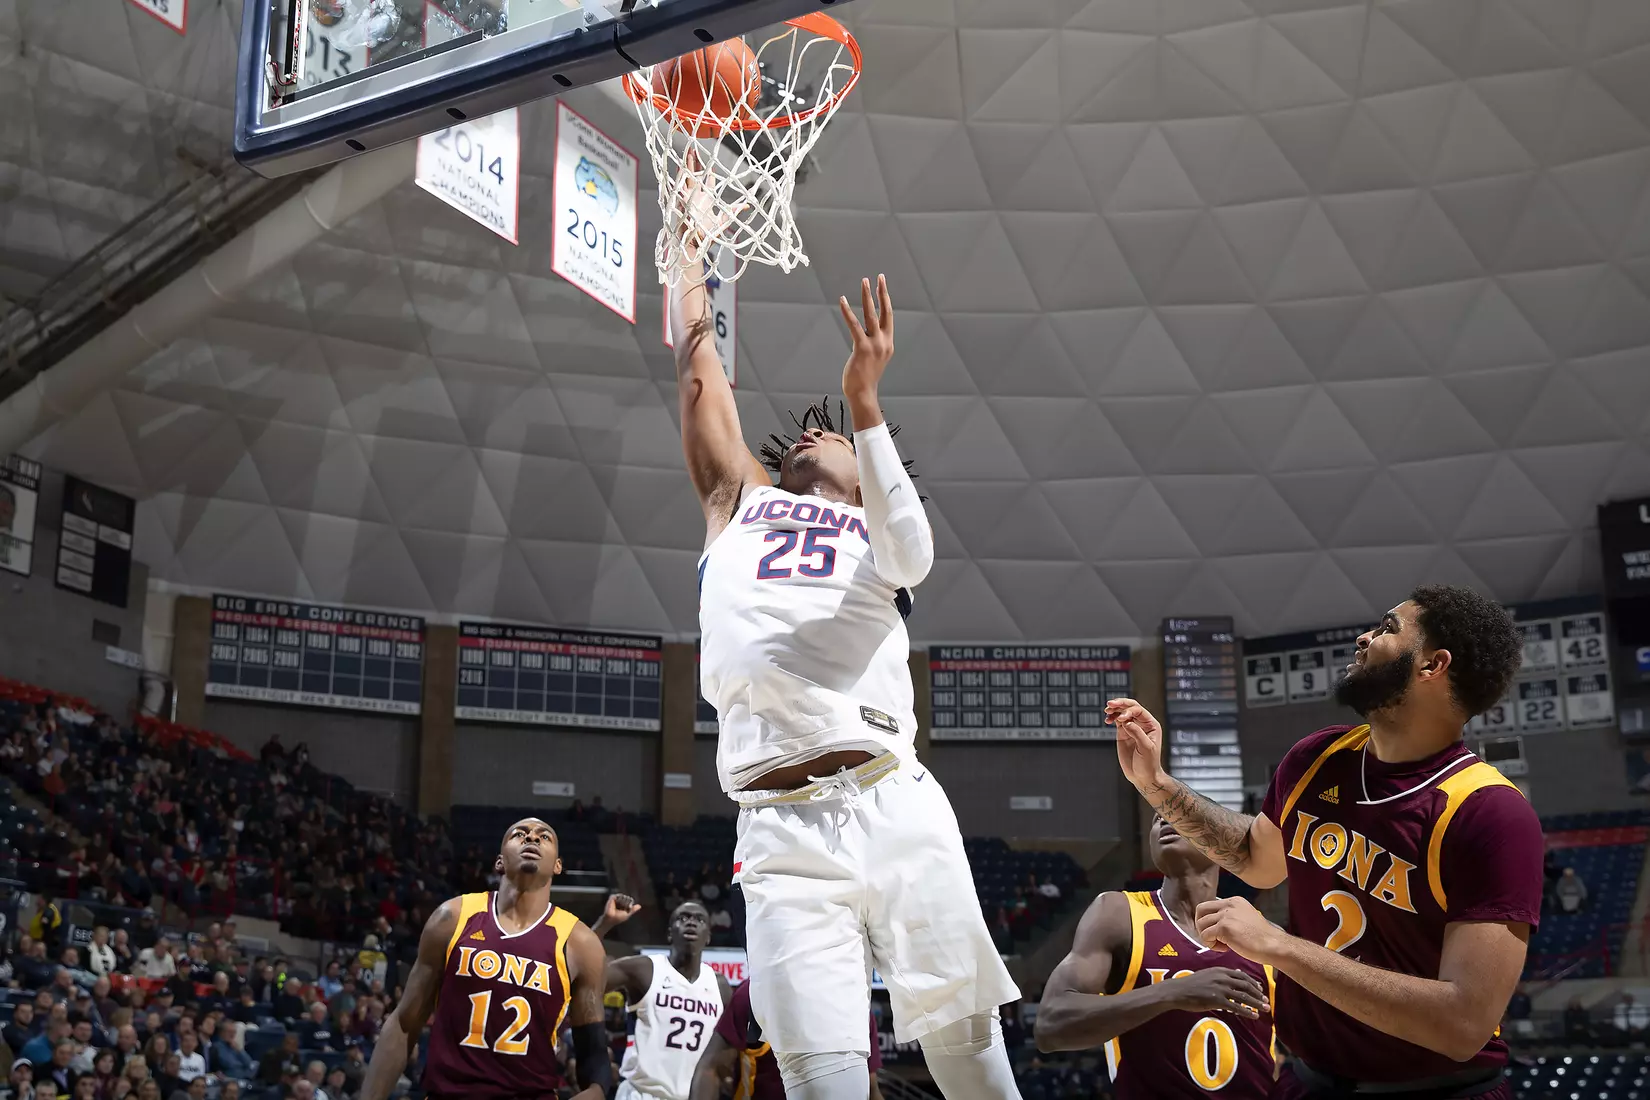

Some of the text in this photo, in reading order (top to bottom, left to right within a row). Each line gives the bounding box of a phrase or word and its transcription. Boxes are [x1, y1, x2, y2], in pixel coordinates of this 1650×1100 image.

[434, 127, 504, 186] 2014
[431, 174, 505, 229] CHAMPIONS
[438, 157, 500, 206] NATIONAL
[567, 208, 623, 268] 2015
[563, 260, 625, 310] CHAMPIONS
[568, 245, 621, 289] NATIONAL
[740, 500, 870, 544] UCONN
[757, 527, 841, 579] 25
[216, 597, 421, 630] BIG EAST CONFERENCE
[477, 637, 644, 659] TOURNAMENT CHAMPIONS
[940, 648, 1120, 659] NCAA CHAMPIONSHIP
[1567, 638, 1601, 659] 42
[1303, 672, 1314, 690] 9
[460, 707, 540, 723] CONNECTICUT
[1482, 706, 1506, 726] 13
[1525, 701, 1556, 722] 22
[1318, 793, 1341, 805] adidas
[1288, 811, 1418, 914] IONA
[1321, 889, 1367, 953] 2
[455, 946, 553, 996] IONA
[459, 990, 532, 1056] 12
[655, 992, 719, 1018] UCONN
[665, 1016, 704, 1053] 23
[1184, 1016, 1239, 1092] 0
